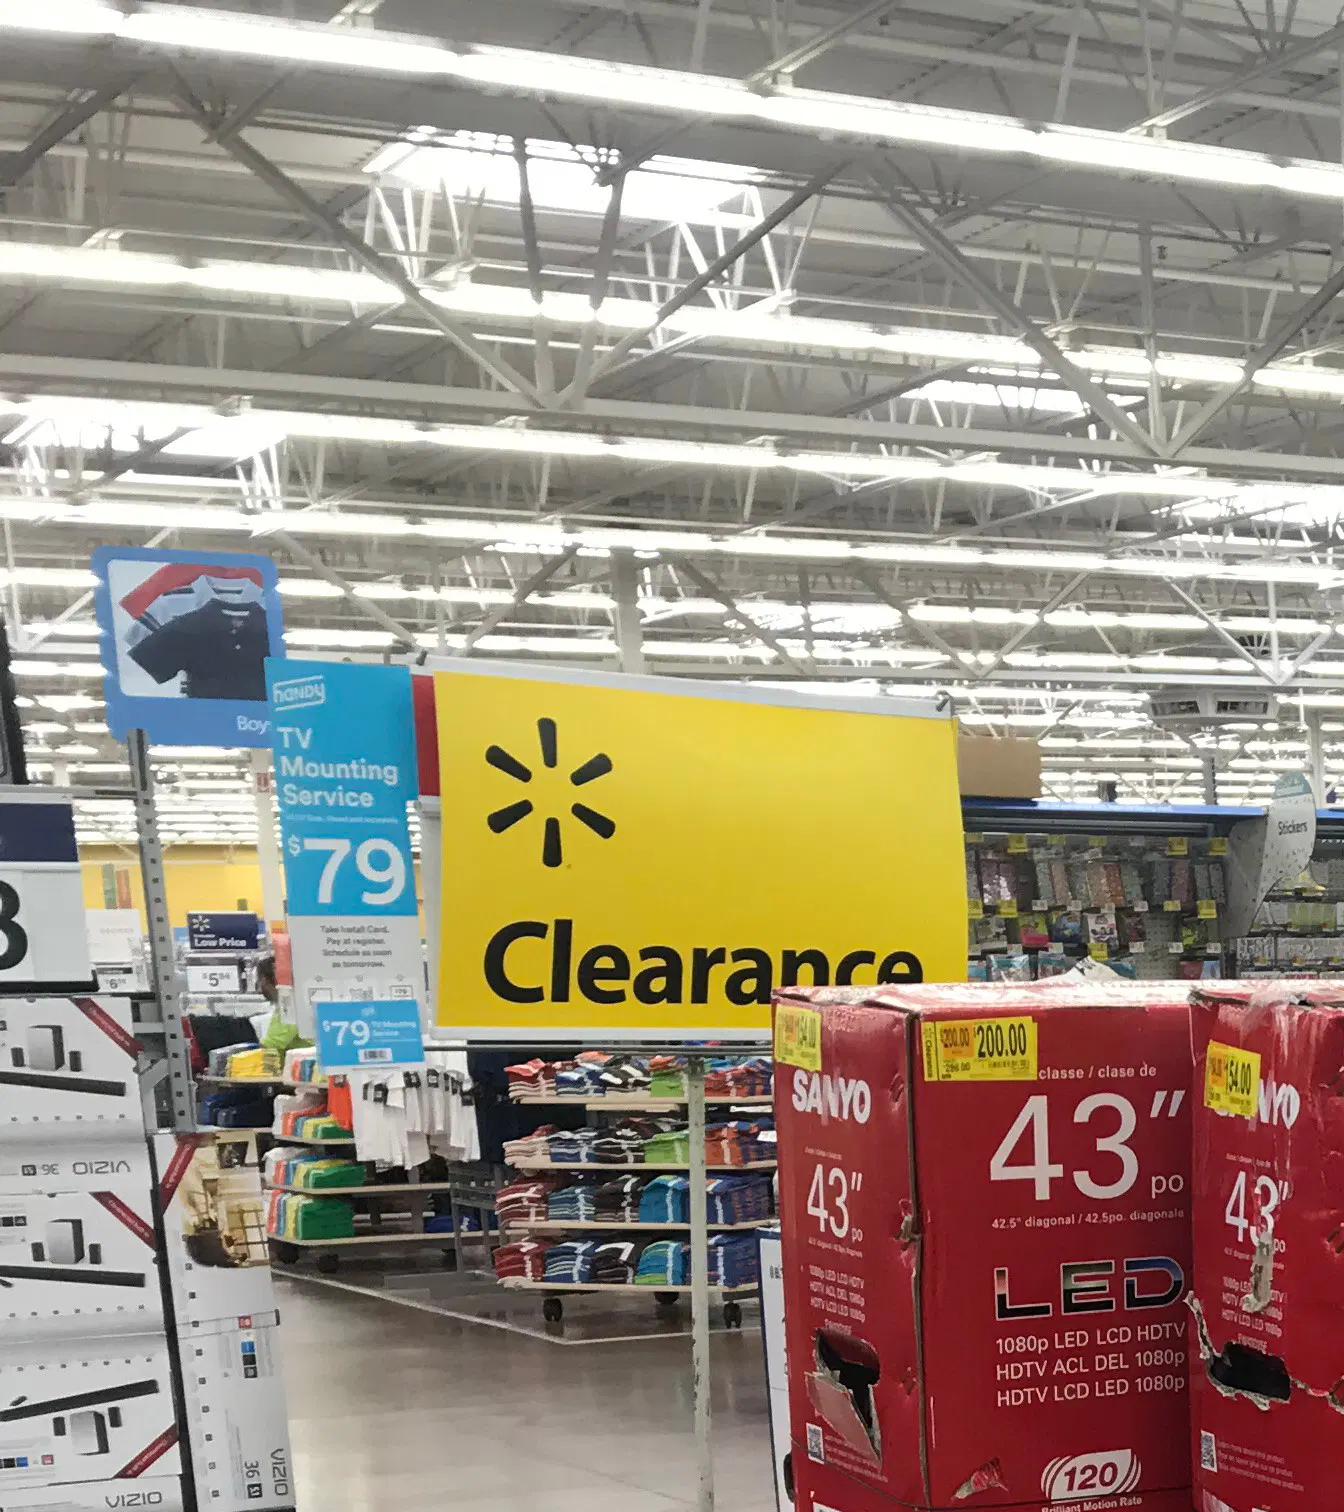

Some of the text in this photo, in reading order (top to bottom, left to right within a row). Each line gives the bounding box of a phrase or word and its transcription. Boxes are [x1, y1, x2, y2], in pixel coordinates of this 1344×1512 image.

[277, 727, 313, 749] TV
[280, 755, 399, 786] Mounting
[283, 784, 375, 808] Service
[1277, 818, 1308, 837] Stickers
[287, 833, 406, 906] $79
[483, 918, 925, 1005] Clearance
[322, 1018, 371, 1048] $79
[1038, 1065, 1135, 1080] classe clase
[792, 1068, 872, 1125] SANYO
[989, 1089, 1186, 1201] 43"
[72, 1160, 131, 1176] VIZIO
[807, 1163, 864, 1239] 43"
[1151, 1174, 1185, 1199] po
[994, 1256, 1185, 1322] LED
[995, 1321, 1186, 1355] 1080p LED LCD HDTV
[996, 1348, 1186, 1381] HDTV ACL DEL 1080p
[997, 1374, 1186, 1408] HDTV LCD LED 1080p
[244, 1460, 261, 1478] 36
[271, 1447, 290, 1496] VIZIO
[1063, 1461, 1119, 1493] 120
[105, 1491, 163, 1508] VIZIO
[1083, 1498, 1118, 1512] Motion
[1119, 1494, 1143, 1508] Rate
